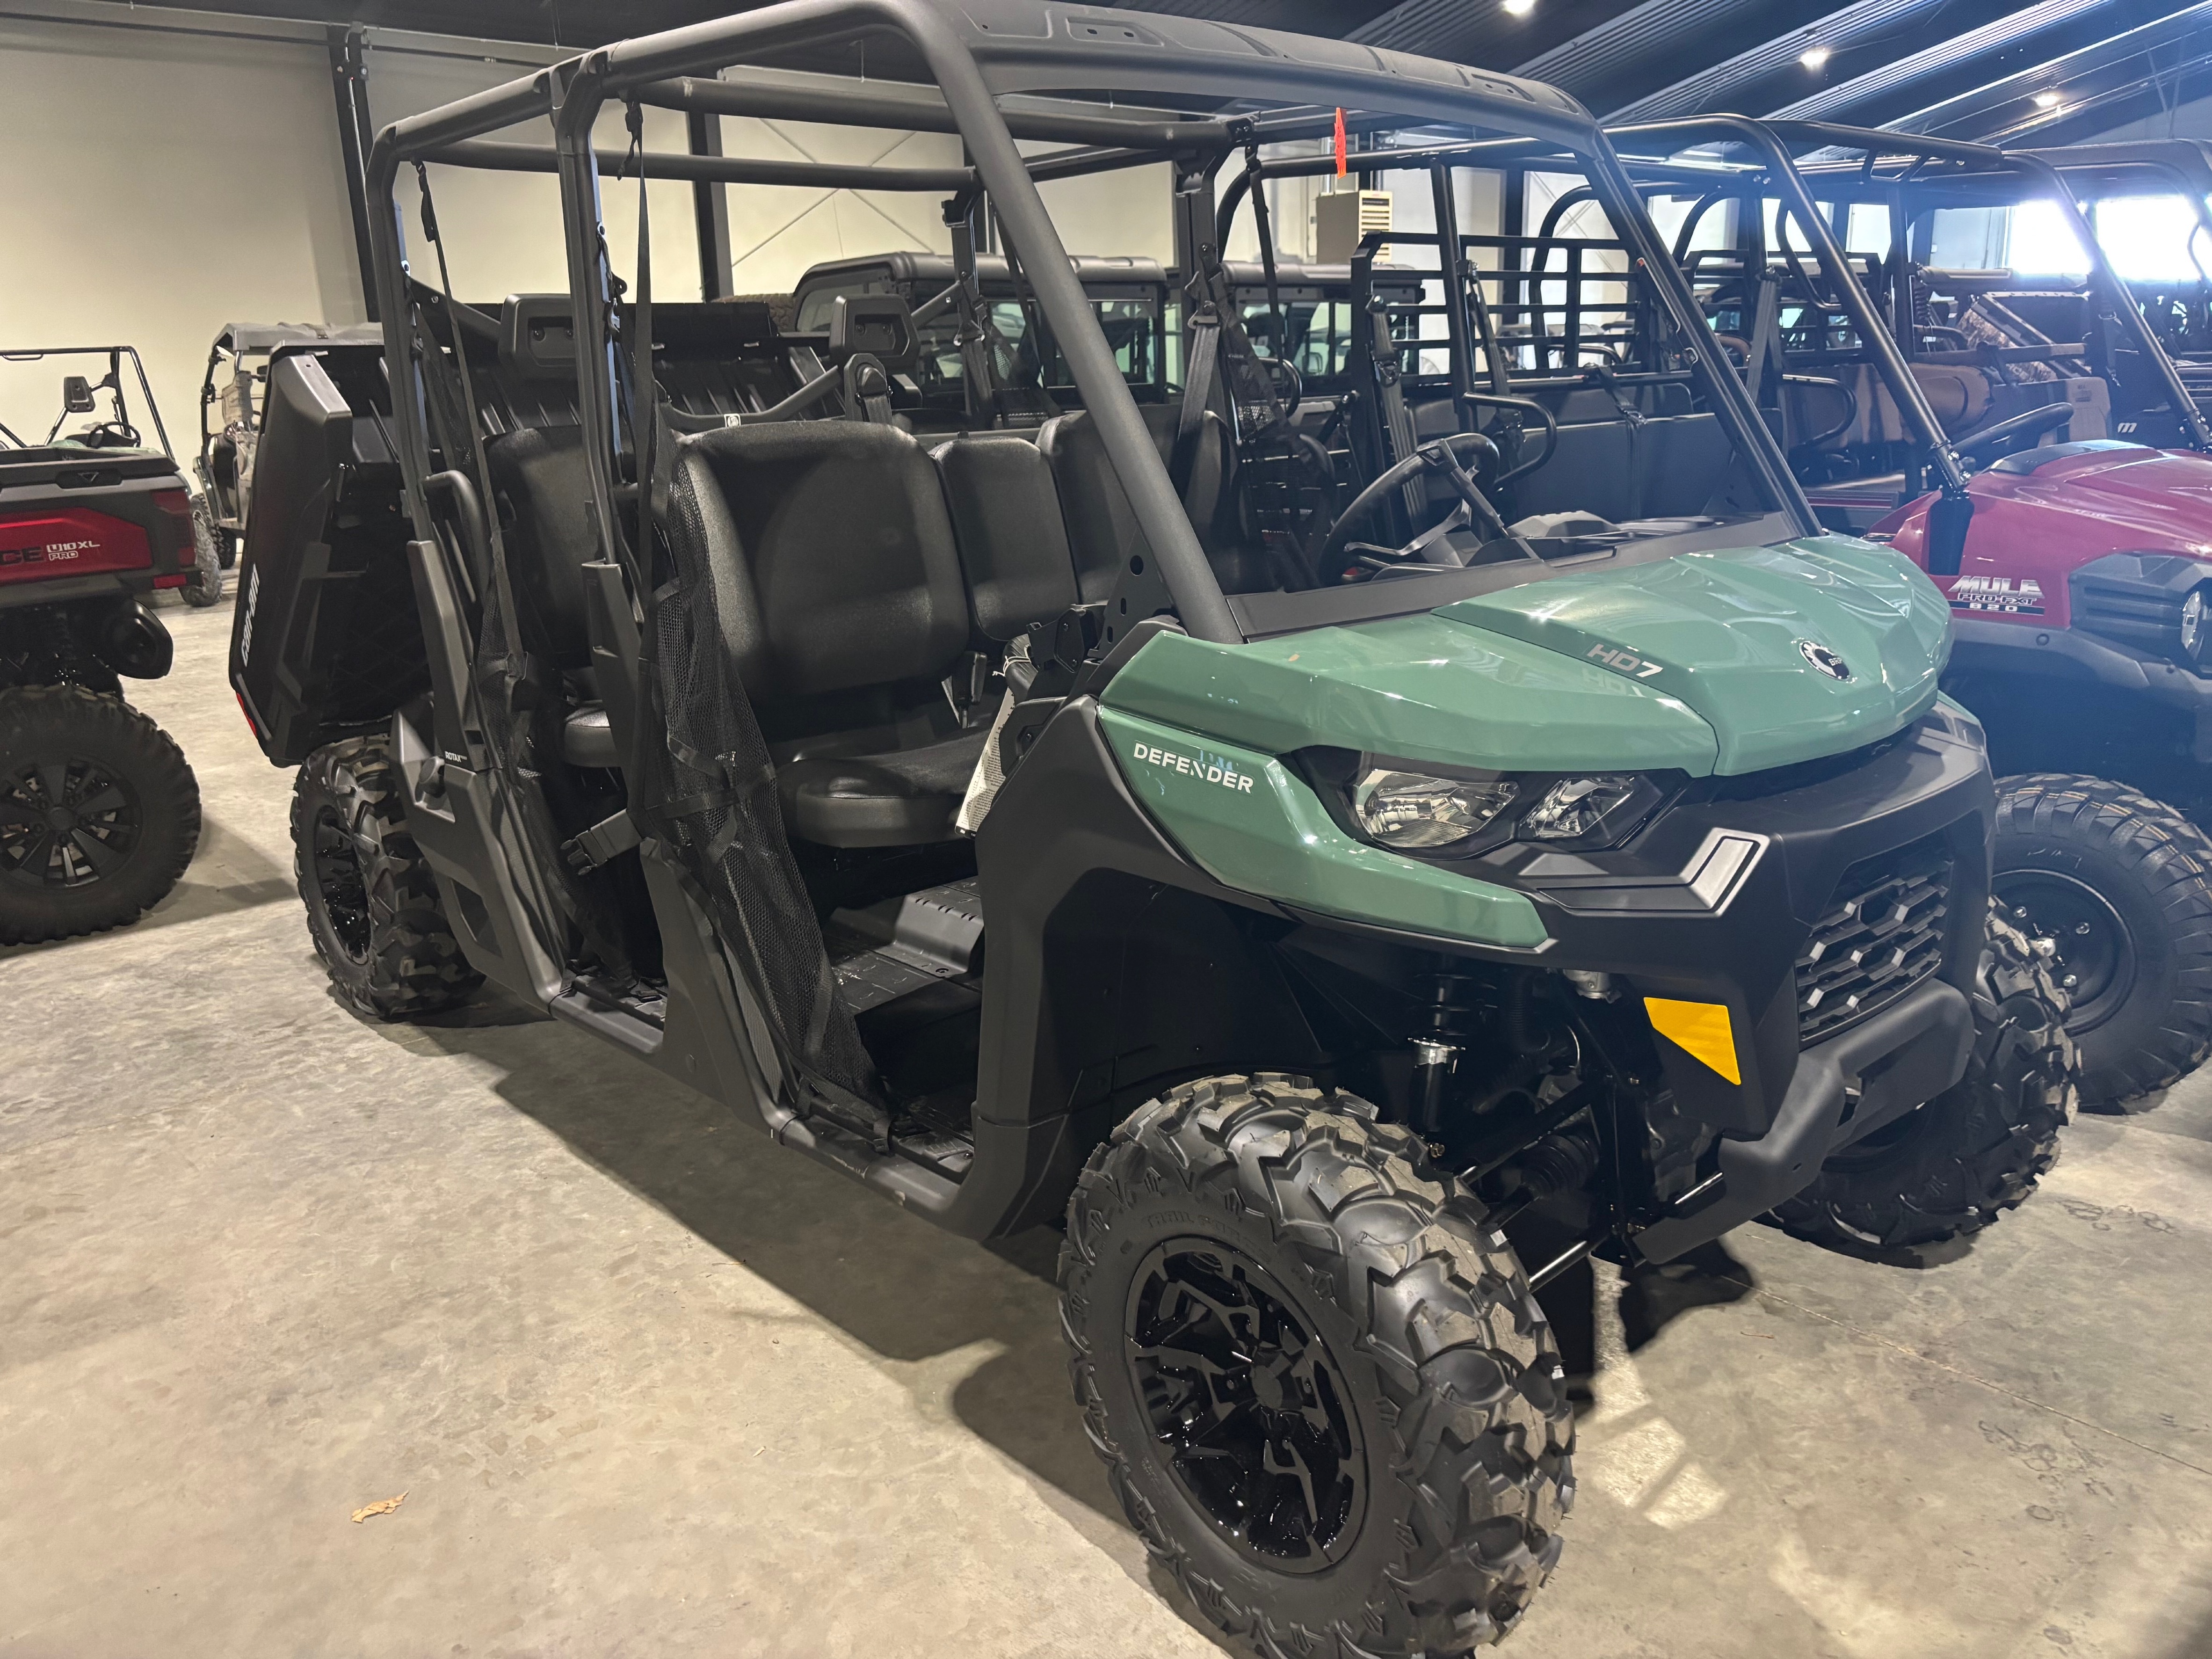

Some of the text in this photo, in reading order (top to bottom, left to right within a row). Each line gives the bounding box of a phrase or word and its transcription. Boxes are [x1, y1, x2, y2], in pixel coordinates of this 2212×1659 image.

[48, 551, 79, 561] PRO
[1948, 575, 2045, 599] MULE
[241, 563, 260, 667] can-am
[1969, 602, 2018, 612] 820
[1587, 643, 1663, 677] HD7
[1828, 657, 1842, 666] BRP
[445, 751, 462, 763] ROTAX
[1133, 742, 1254, 794] DEFENDER
